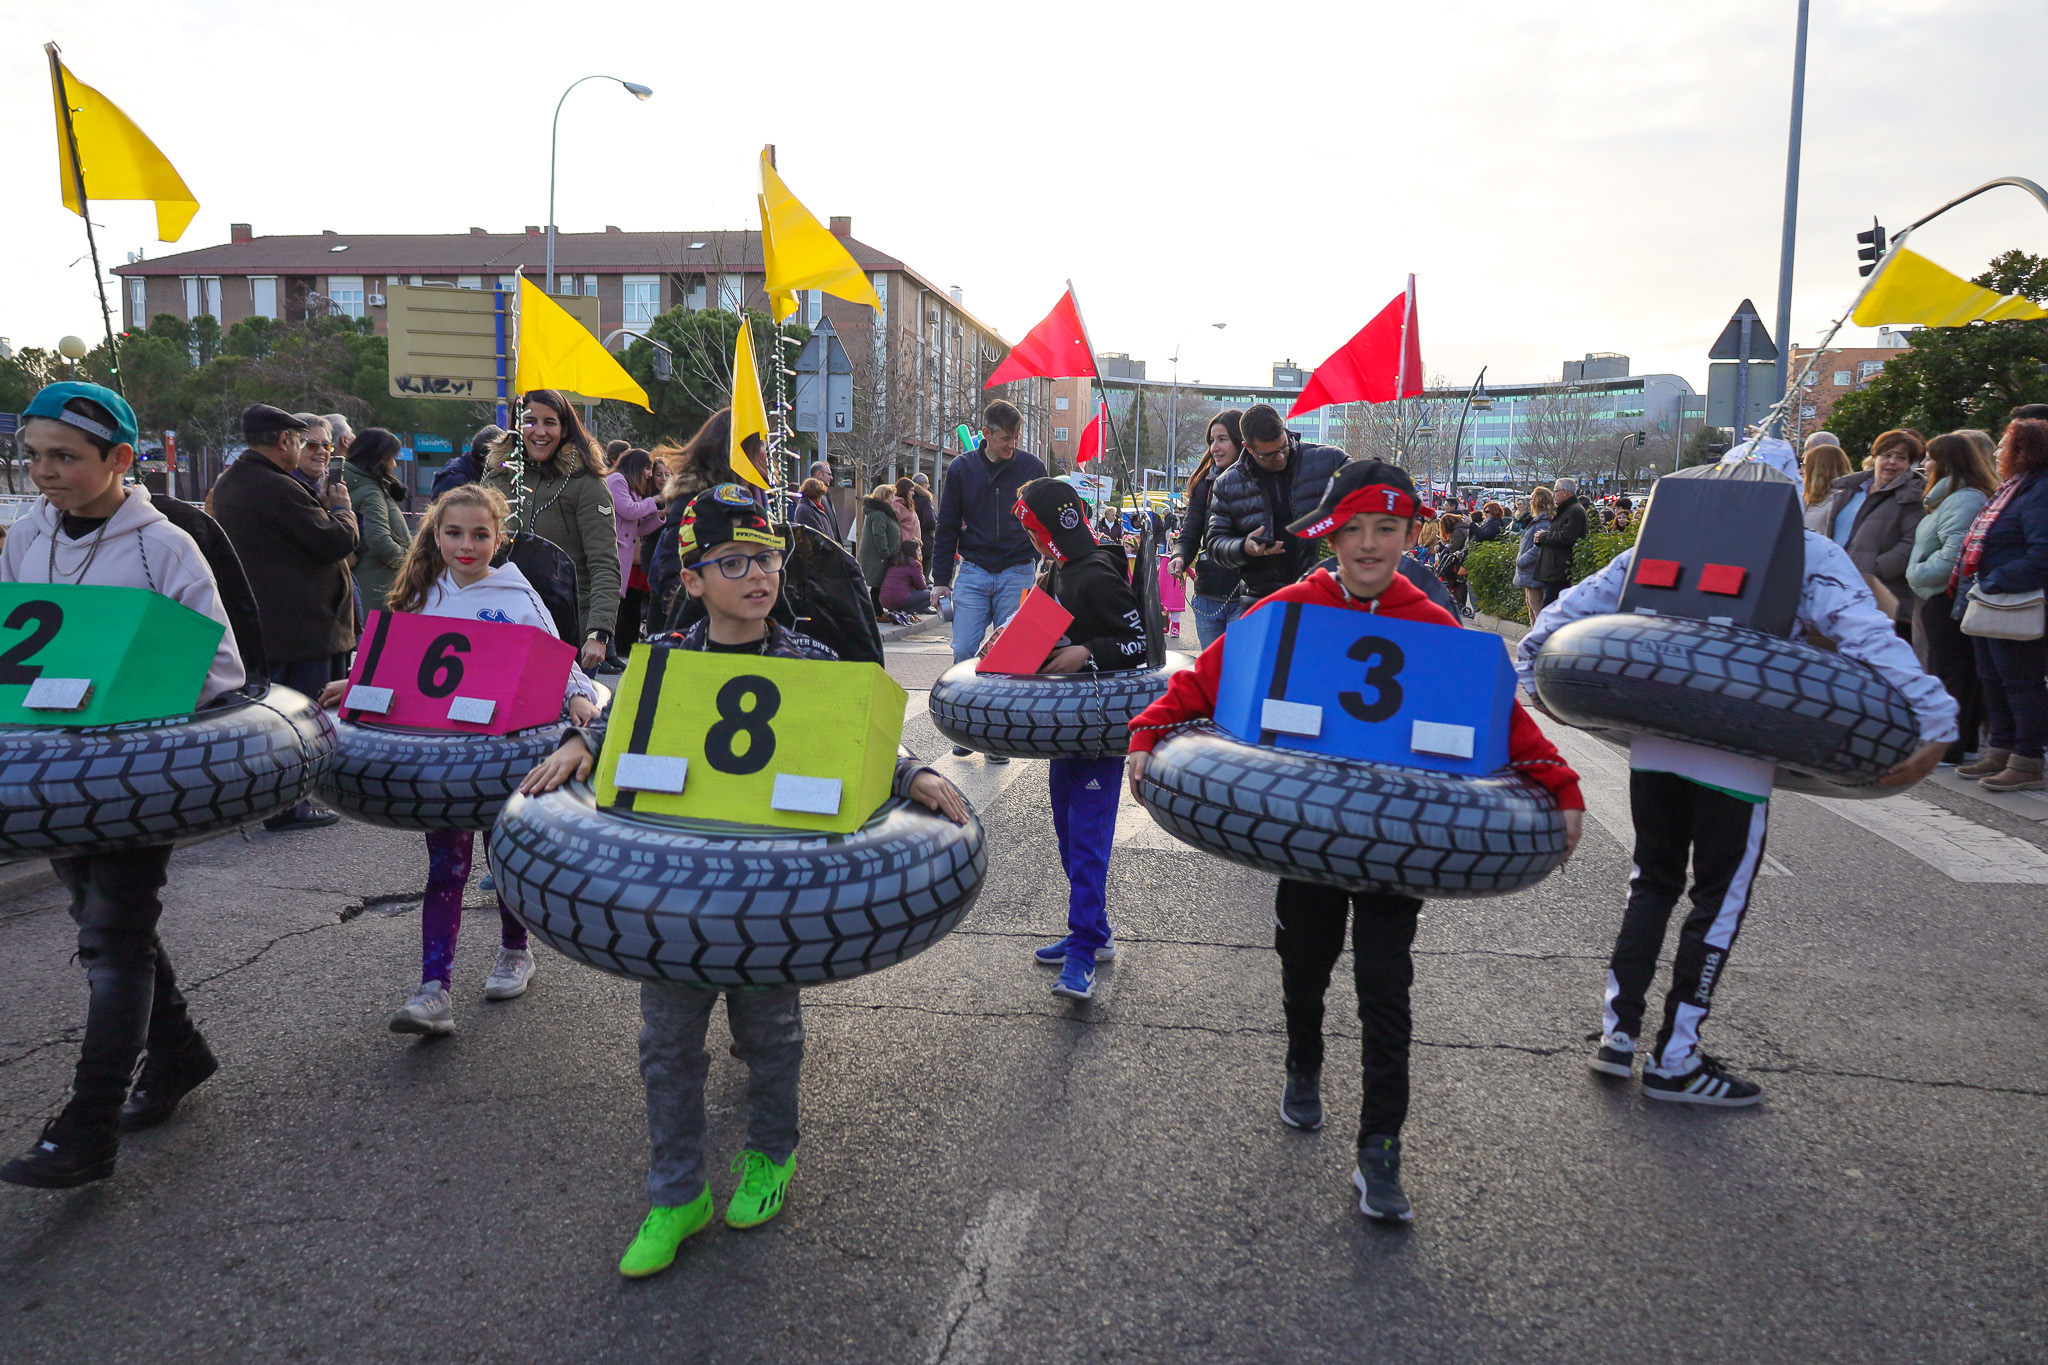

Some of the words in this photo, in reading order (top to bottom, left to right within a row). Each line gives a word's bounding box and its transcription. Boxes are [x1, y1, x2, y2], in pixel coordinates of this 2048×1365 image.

[0, 600, 64, 685] 2
[417, 632, 471, 699] 6
[1338, 635, 1405, 724] 3
[704, 674, 782, 776] 8
